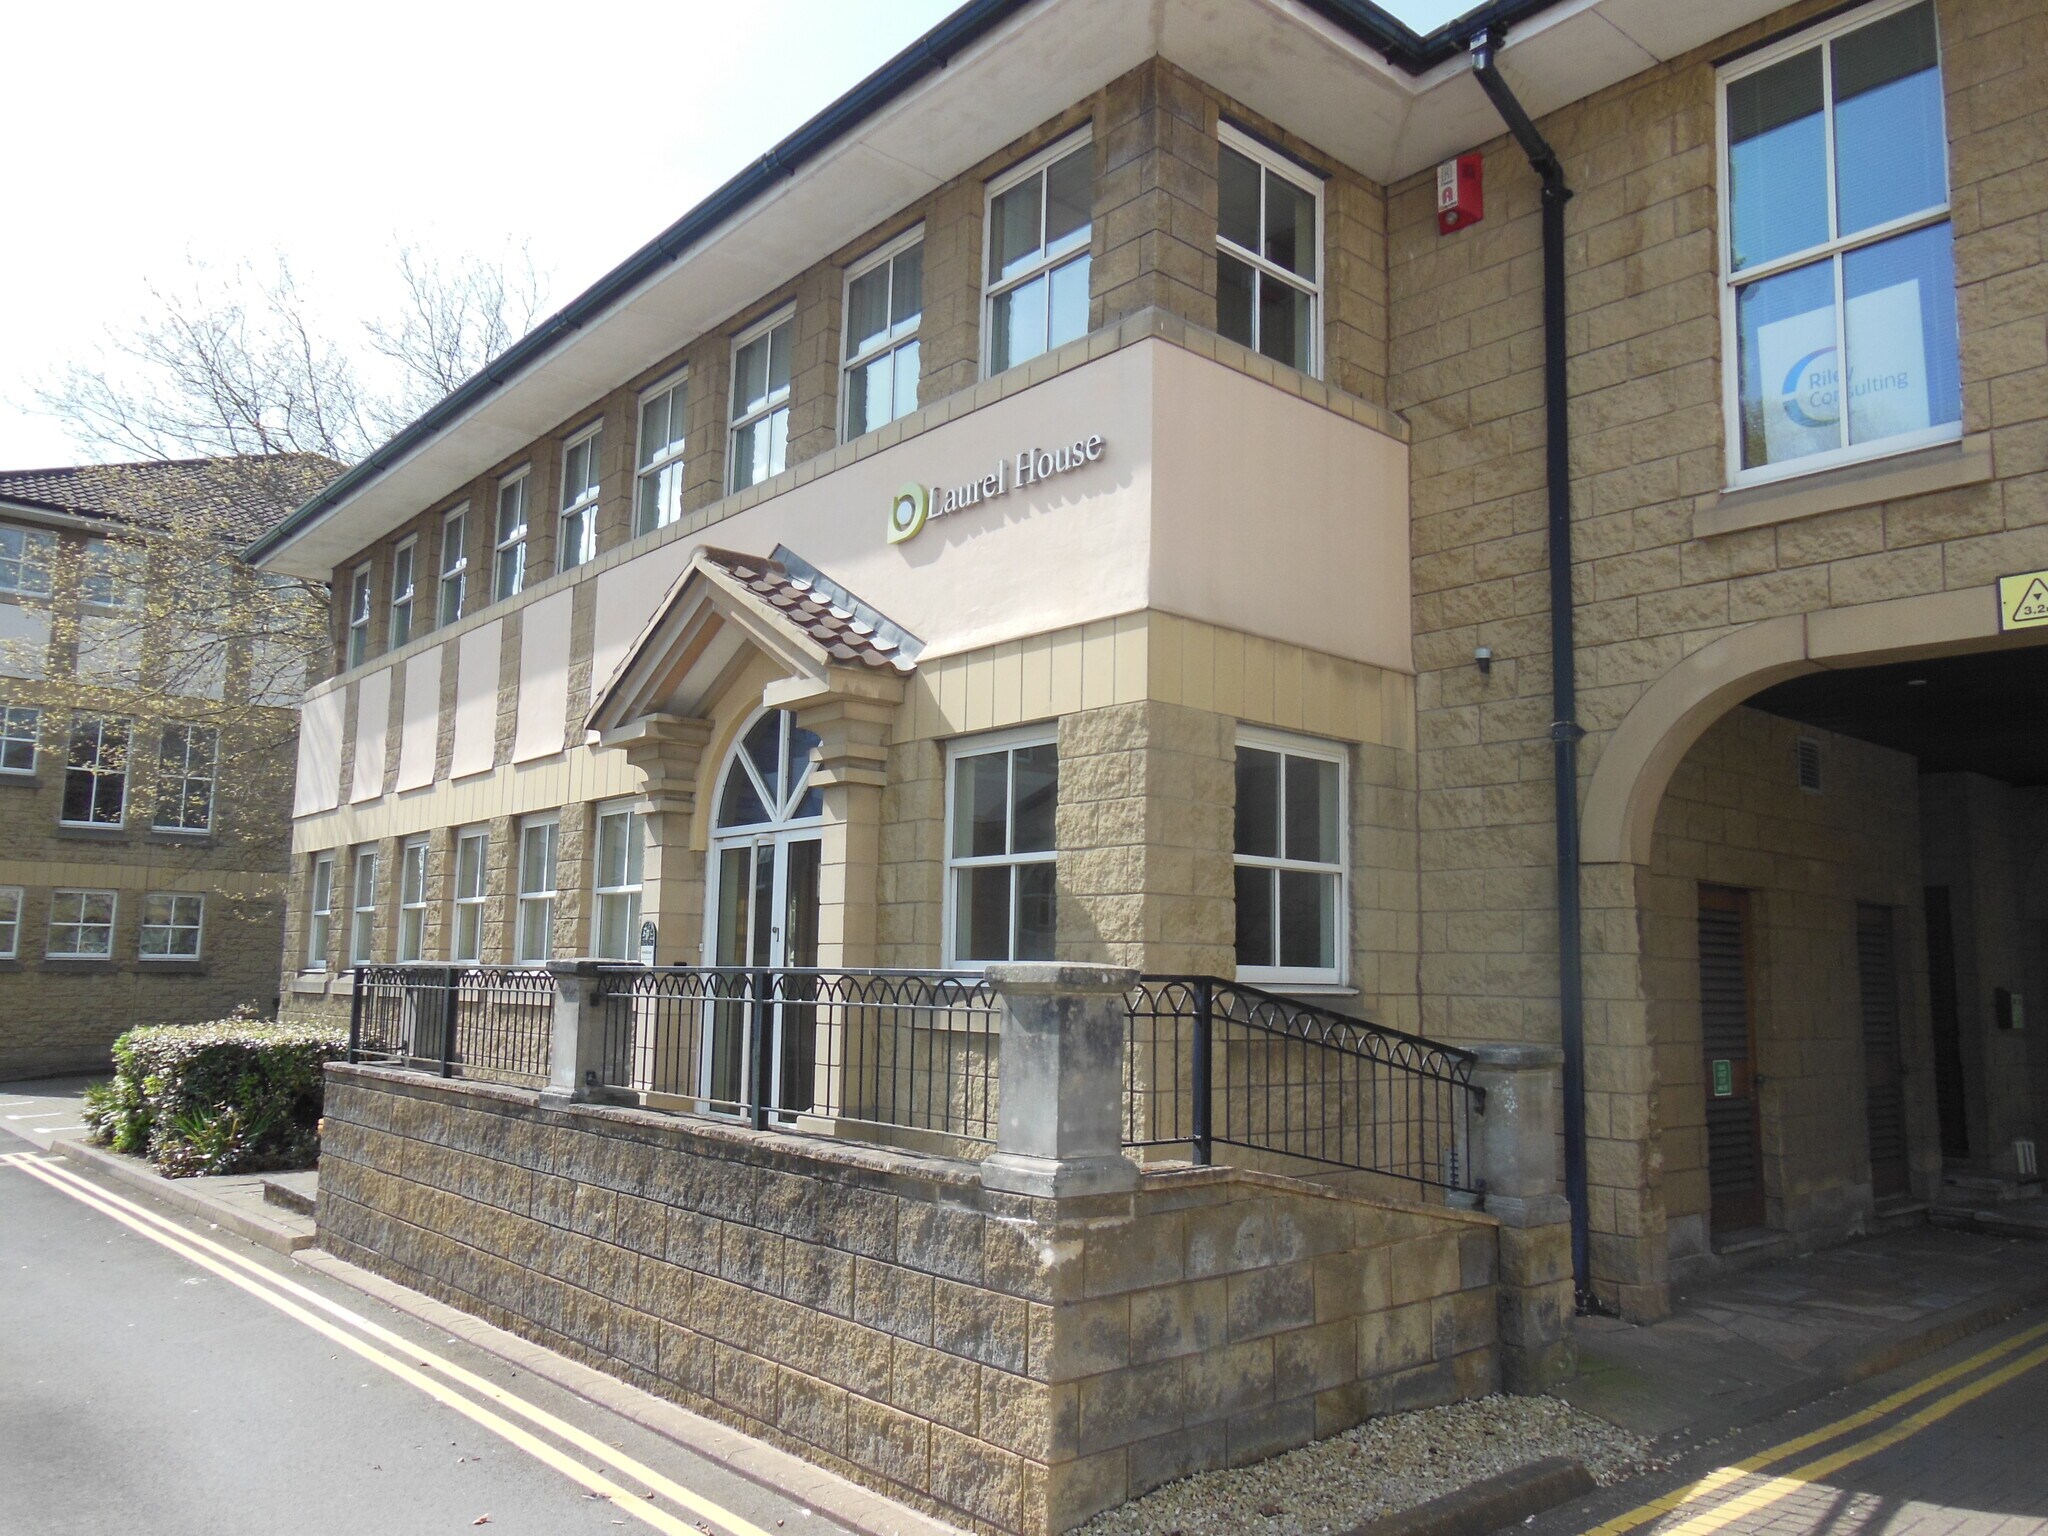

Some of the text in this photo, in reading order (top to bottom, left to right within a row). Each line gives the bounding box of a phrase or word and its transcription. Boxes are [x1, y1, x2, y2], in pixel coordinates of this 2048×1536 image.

[926, 433, 1106, 520] Laurel House
[2024, 604, 2048, 615] 3.2
